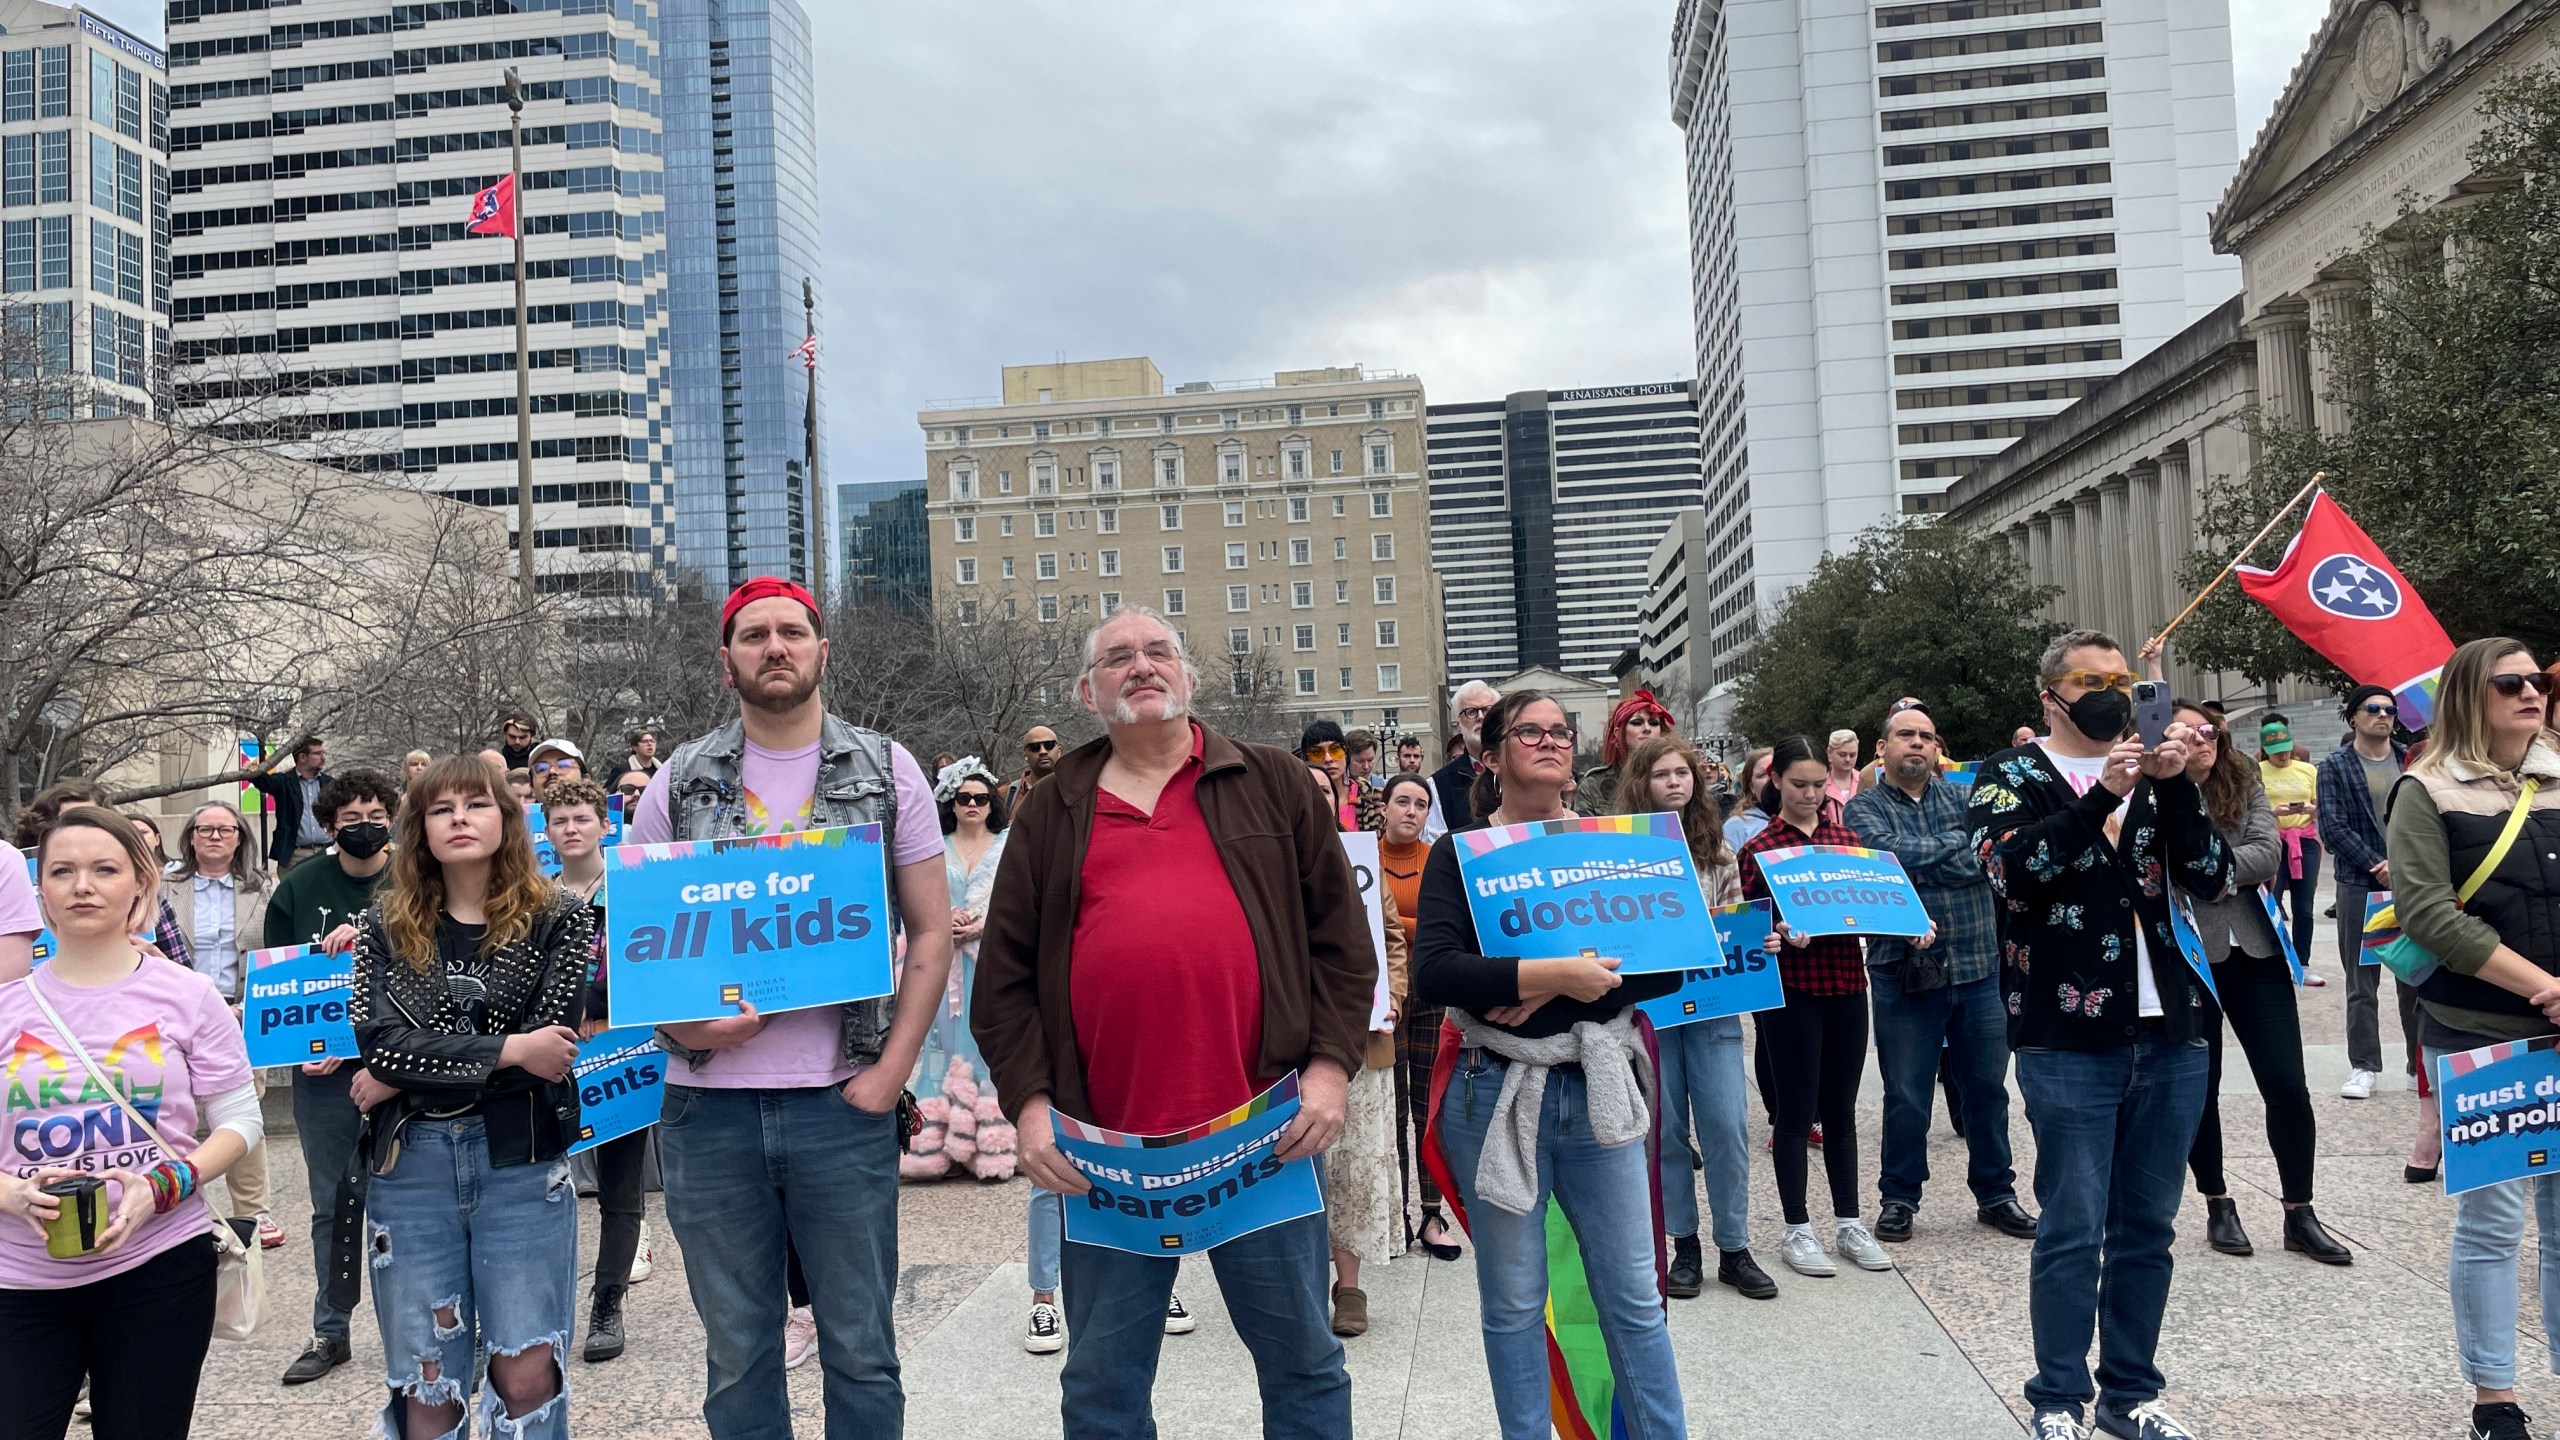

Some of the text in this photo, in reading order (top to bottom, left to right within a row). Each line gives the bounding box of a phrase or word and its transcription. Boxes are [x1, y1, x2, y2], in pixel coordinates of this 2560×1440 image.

[85, 19, 166, 70] FIFTH THIRD B
[2388, 154, 2415, 184] BLOOD
[2416, 140, 2437, 166] AND
[1562, 383, 1675, 401] RENAISSANCE HOTEL
[681, 872, 815, 904] care for
[1475, 858, 1685, 897] trust politicians
[1773, 868, 1905, 886] trust politicians
[1790, 885, 1908, 907] doctors
[624, 897, 873, 963] all kids
[1499, 889, 1686, 938] doctors
[252, 978, 299, 999] trust
[581, 1064, 660, 1108] ents
[2456, 1075, 2560, 1113] trust d
[2451, 1114, 2500, 1143] not
[76, 1156, 96, 1174] IS
[103, 1146, 160, 1170] LOVE
[1064, 1119, 1295, 1190] trust politicians
[1087, 1153, 1285, 1220] parents
